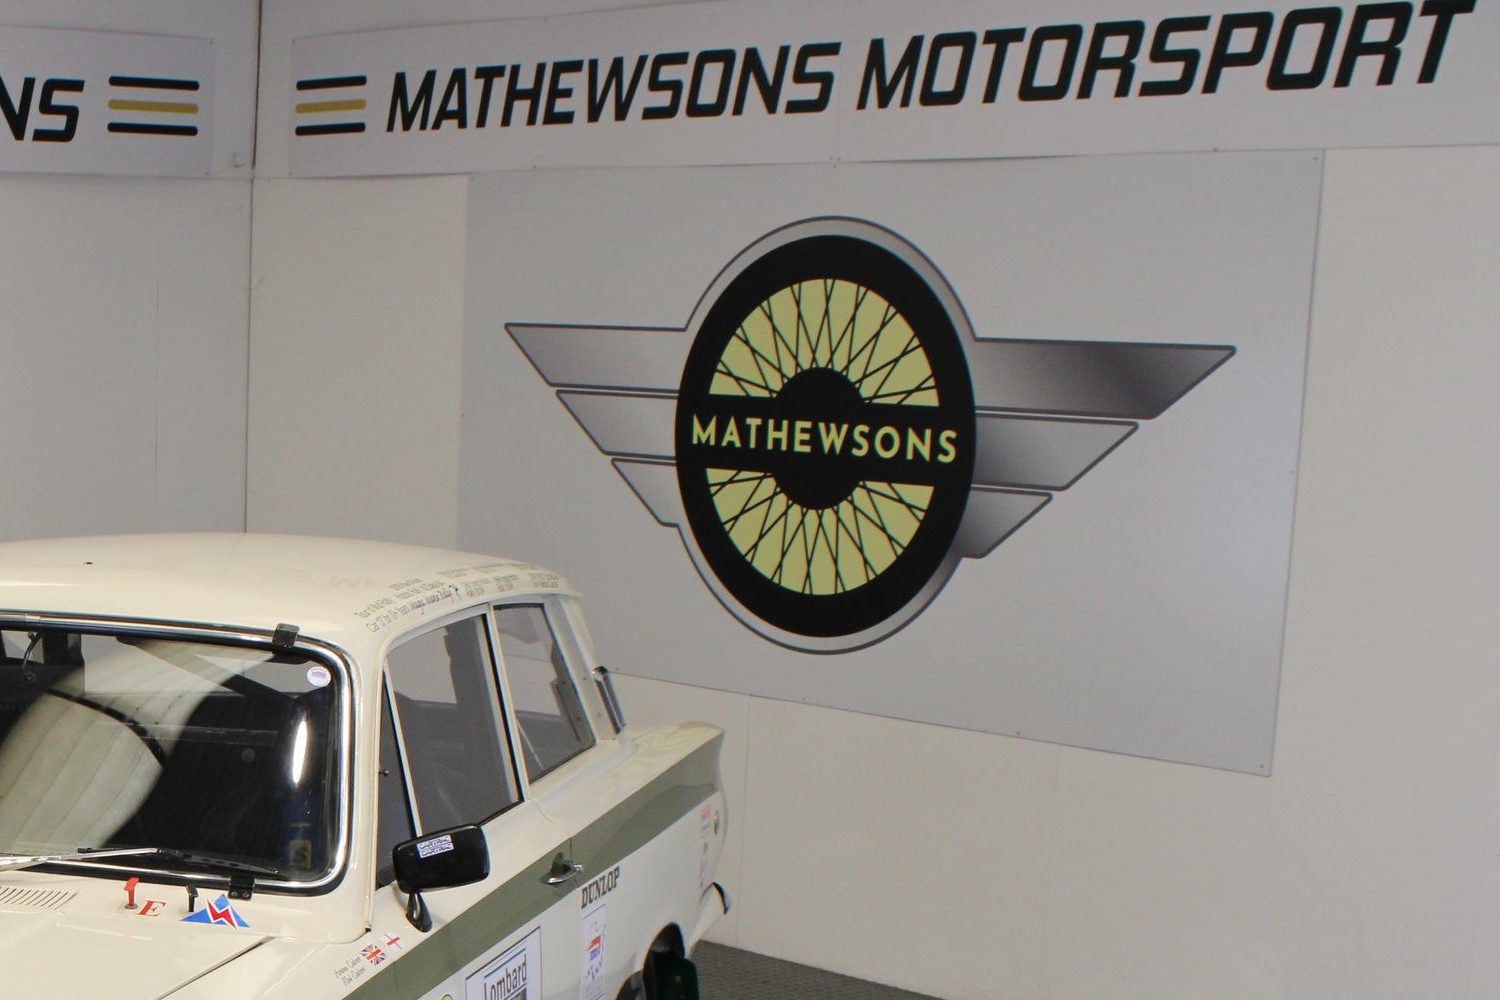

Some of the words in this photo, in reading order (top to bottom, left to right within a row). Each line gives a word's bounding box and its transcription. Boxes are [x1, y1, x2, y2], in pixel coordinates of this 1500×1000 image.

[386, 42, 843, 134] MATHEWSONS
[856, 0, 1478, 112] MOTORSPORT
[691, 414, 959, 464] MATHEWSONS
[136, 899, 167, 918] E
[581, 866, 620, 910] DUNLOP
